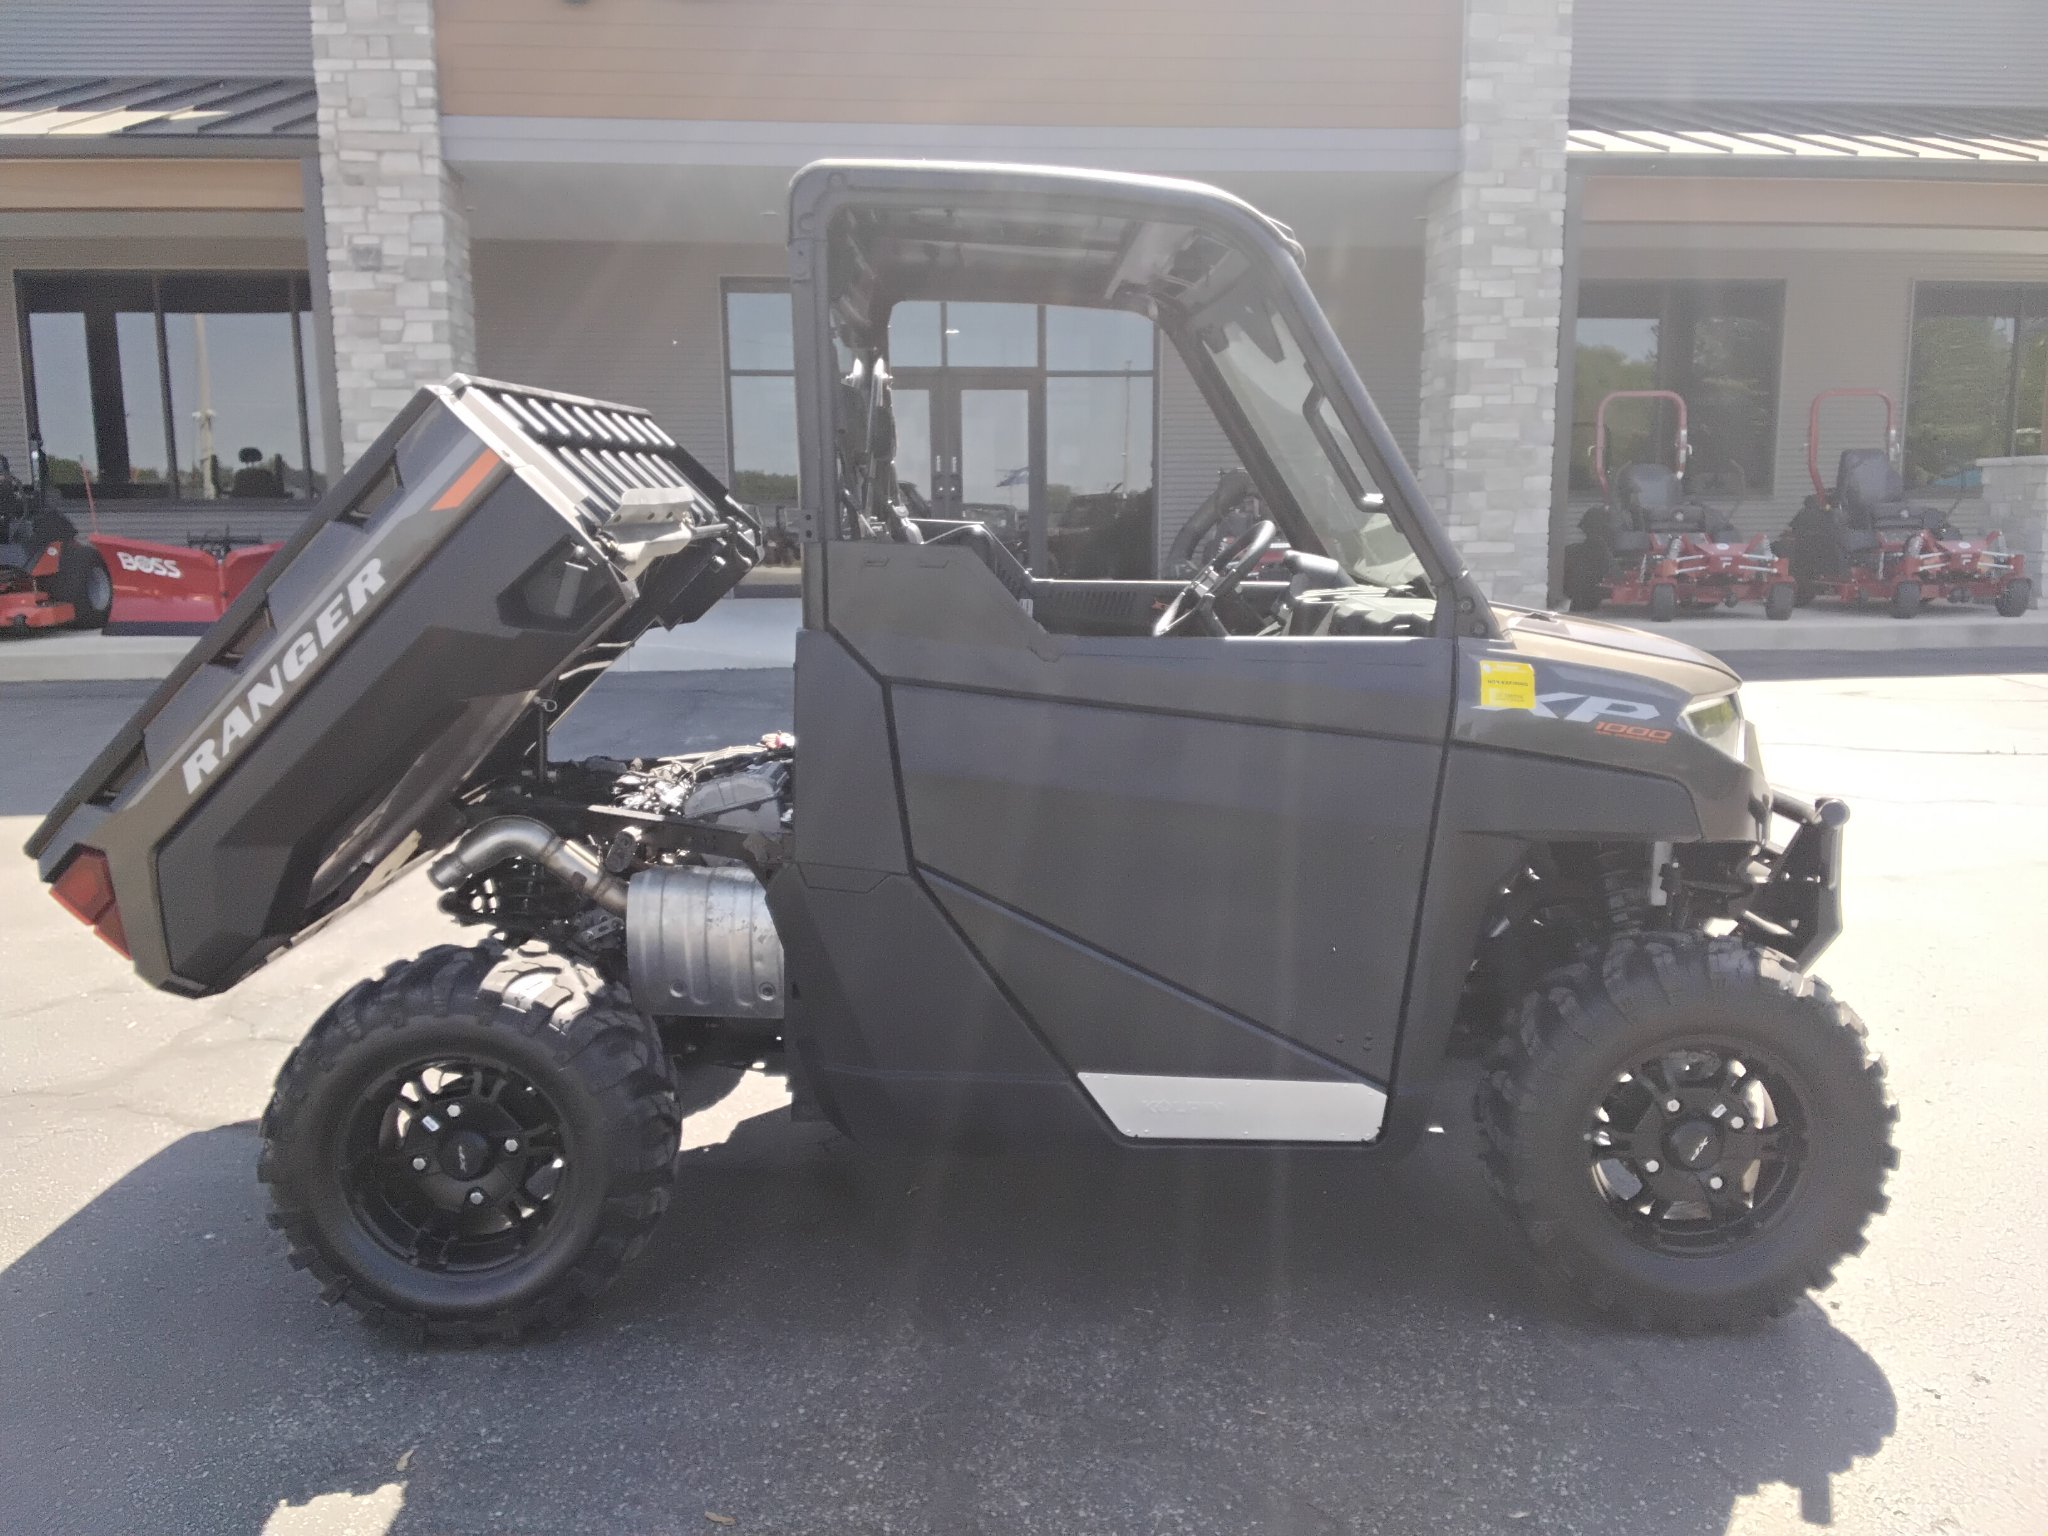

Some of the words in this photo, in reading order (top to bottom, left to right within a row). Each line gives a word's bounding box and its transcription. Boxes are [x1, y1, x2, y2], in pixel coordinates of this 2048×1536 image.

[116, 551, 181, 579] BOSS
[182, 558, 386, 794] RANGER
[1595, 721, 1673, 741] 1000
